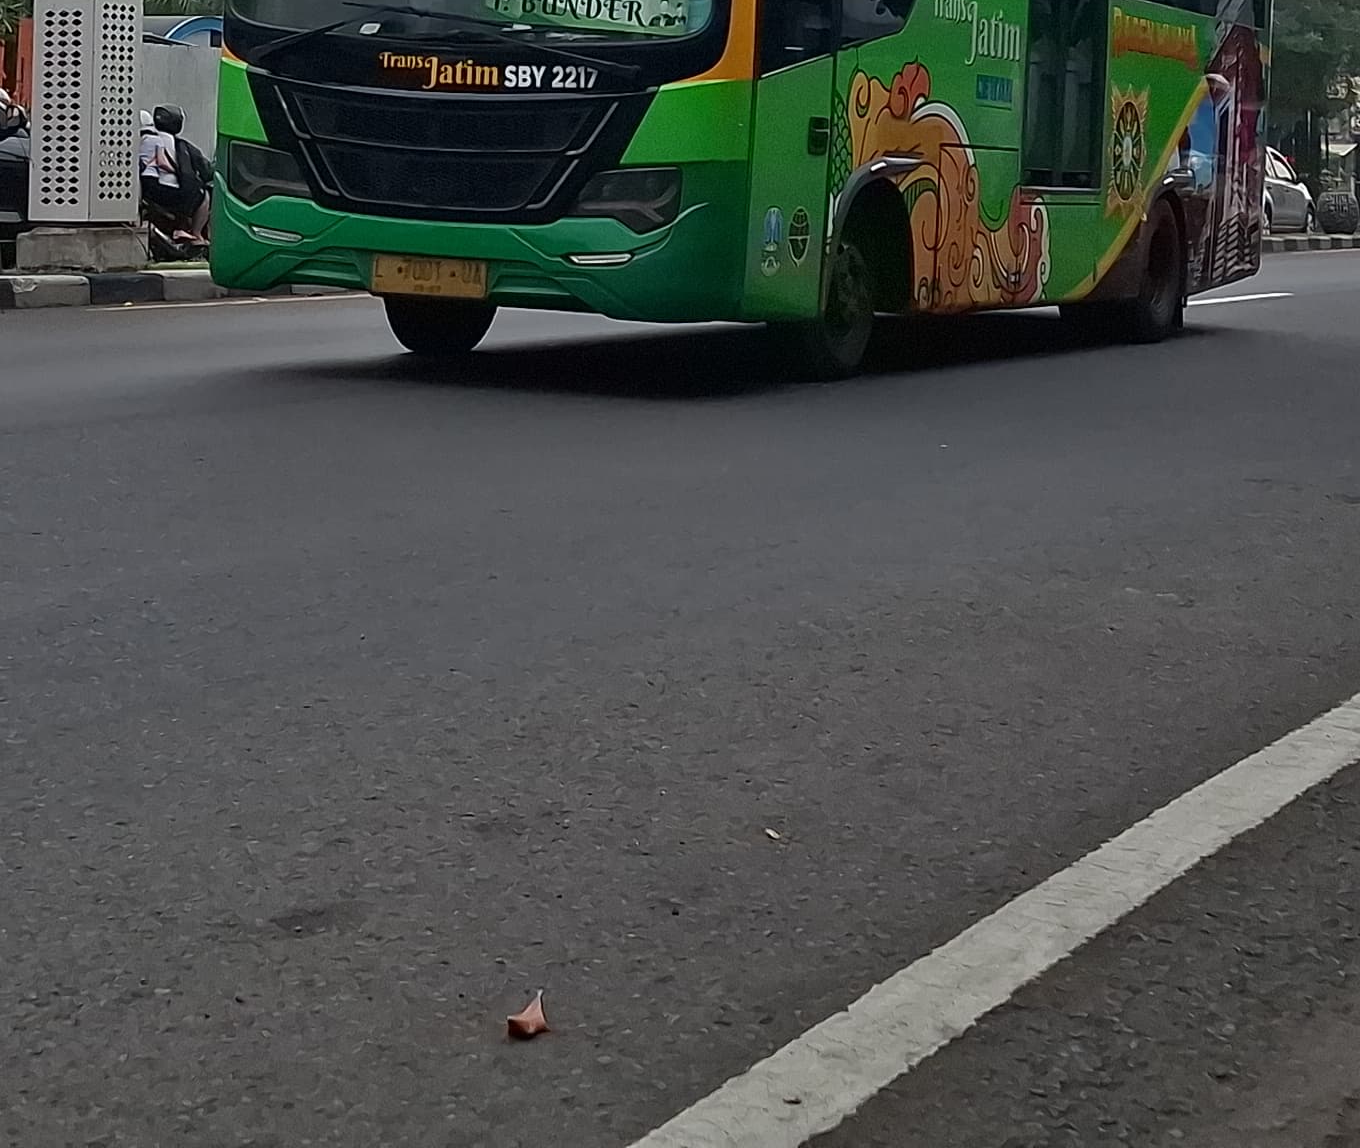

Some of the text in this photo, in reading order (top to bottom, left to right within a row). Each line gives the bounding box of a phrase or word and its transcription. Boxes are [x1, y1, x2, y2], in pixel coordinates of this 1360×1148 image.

[965, 1, 1020, 65] Jatim
[379, 51, 599, 91] Trans Jatim SBY 2217
